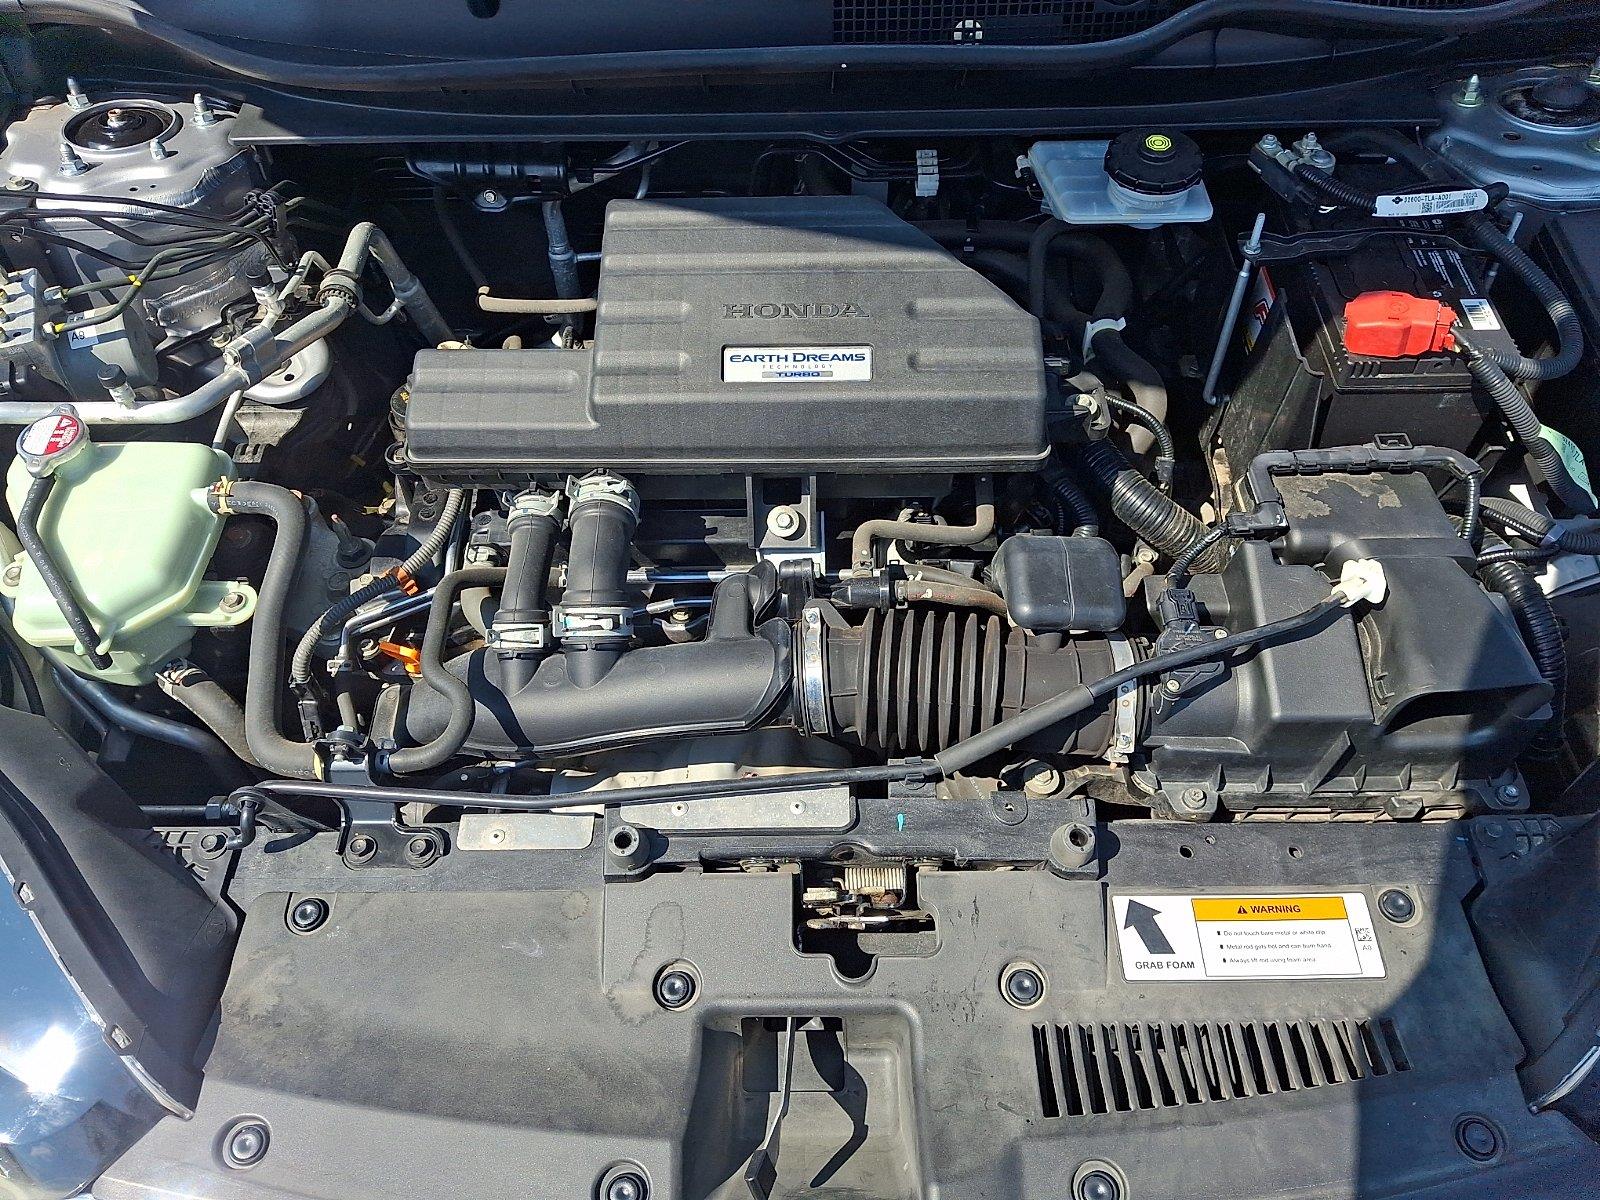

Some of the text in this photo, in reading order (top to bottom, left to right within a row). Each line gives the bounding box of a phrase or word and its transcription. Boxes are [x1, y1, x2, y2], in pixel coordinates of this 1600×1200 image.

[722, 303, 870, 319] HONDA
[729, 353, 866, 363] EARTH DREAMS
[1250, 904, 1301, 914] WARNING
[1135, 961, 1195, 970] GRAB FOAM
